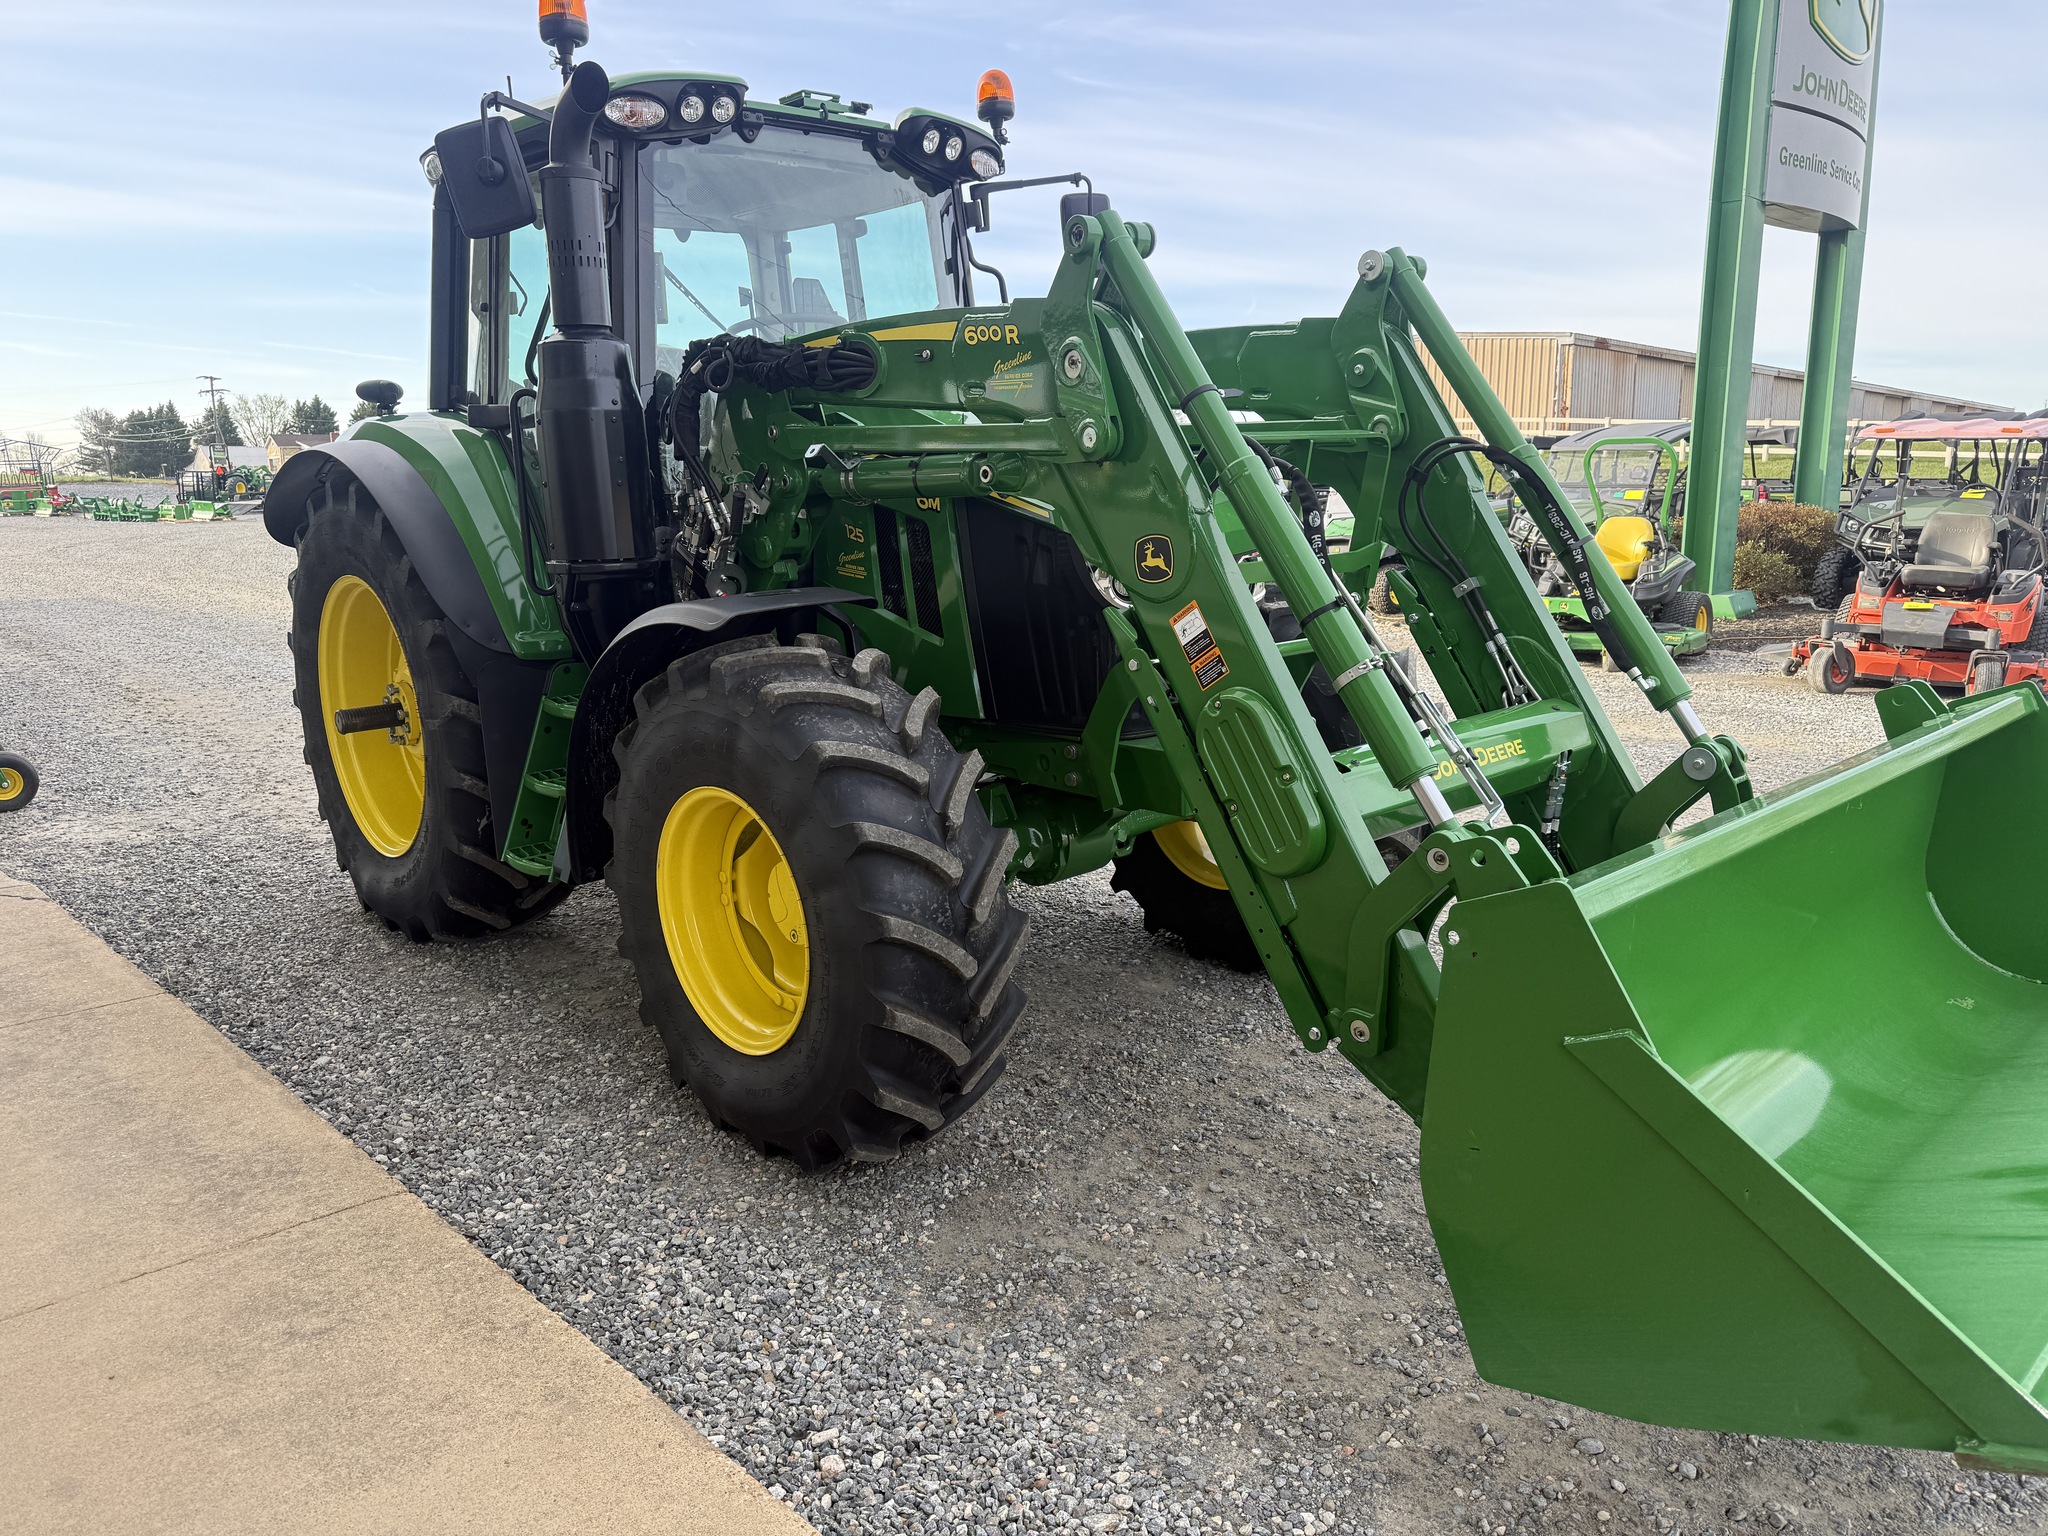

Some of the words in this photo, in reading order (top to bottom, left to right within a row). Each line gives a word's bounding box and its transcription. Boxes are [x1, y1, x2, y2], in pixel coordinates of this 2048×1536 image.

[1792, 64, 1839, 105] JOHN
[1779, 146, 1828, 176] Greenline
[1829, 159, 1852, 186] Service
[993, 350, 1033, 379] Greenline
[844, 523, 865, 543] 125
[1566, 539, 1584, 564] MSA
[1578, 571, 1596, 600] HG-16
[1473, 738, 1527, 767] DEERE
